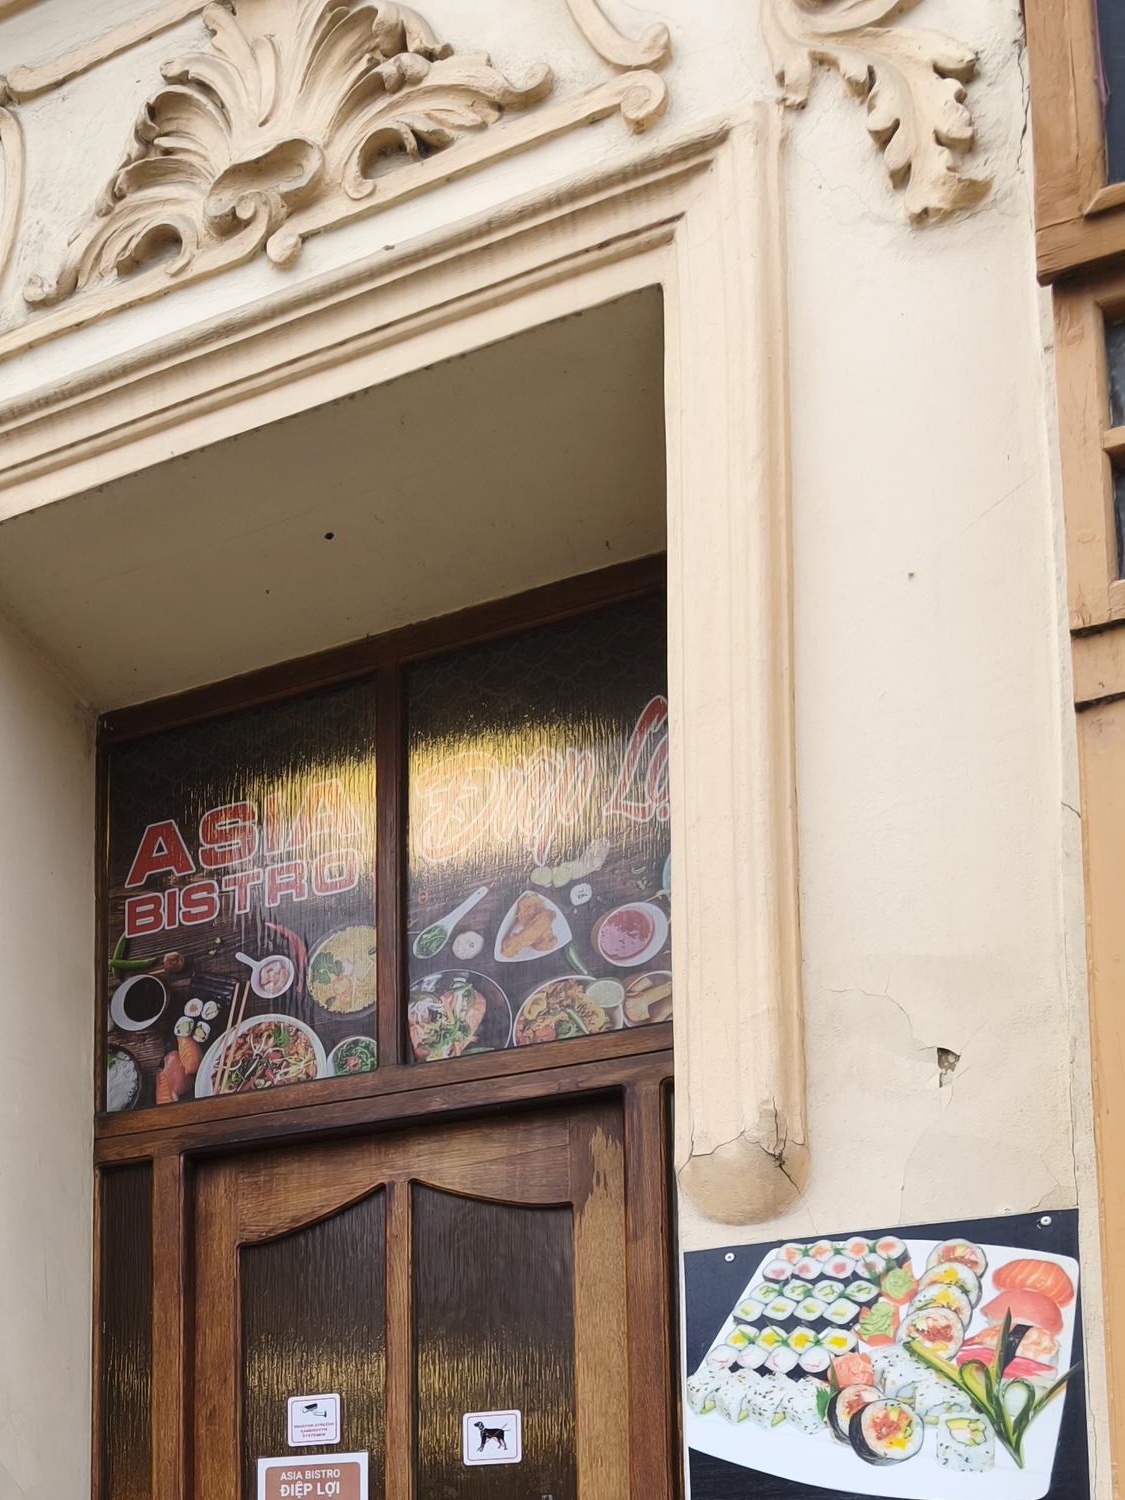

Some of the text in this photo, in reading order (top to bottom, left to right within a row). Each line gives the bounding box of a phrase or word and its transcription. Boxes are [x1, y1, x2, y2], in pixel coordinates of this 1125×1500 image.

[125, 779, 362, 888] ASIA
[125, 848, 360, 937] BISTRO
[280, 1481, 339, 1499] ĐIỆP LỢI
[281, 1469, 340, 1480] ASIA BISTRO
